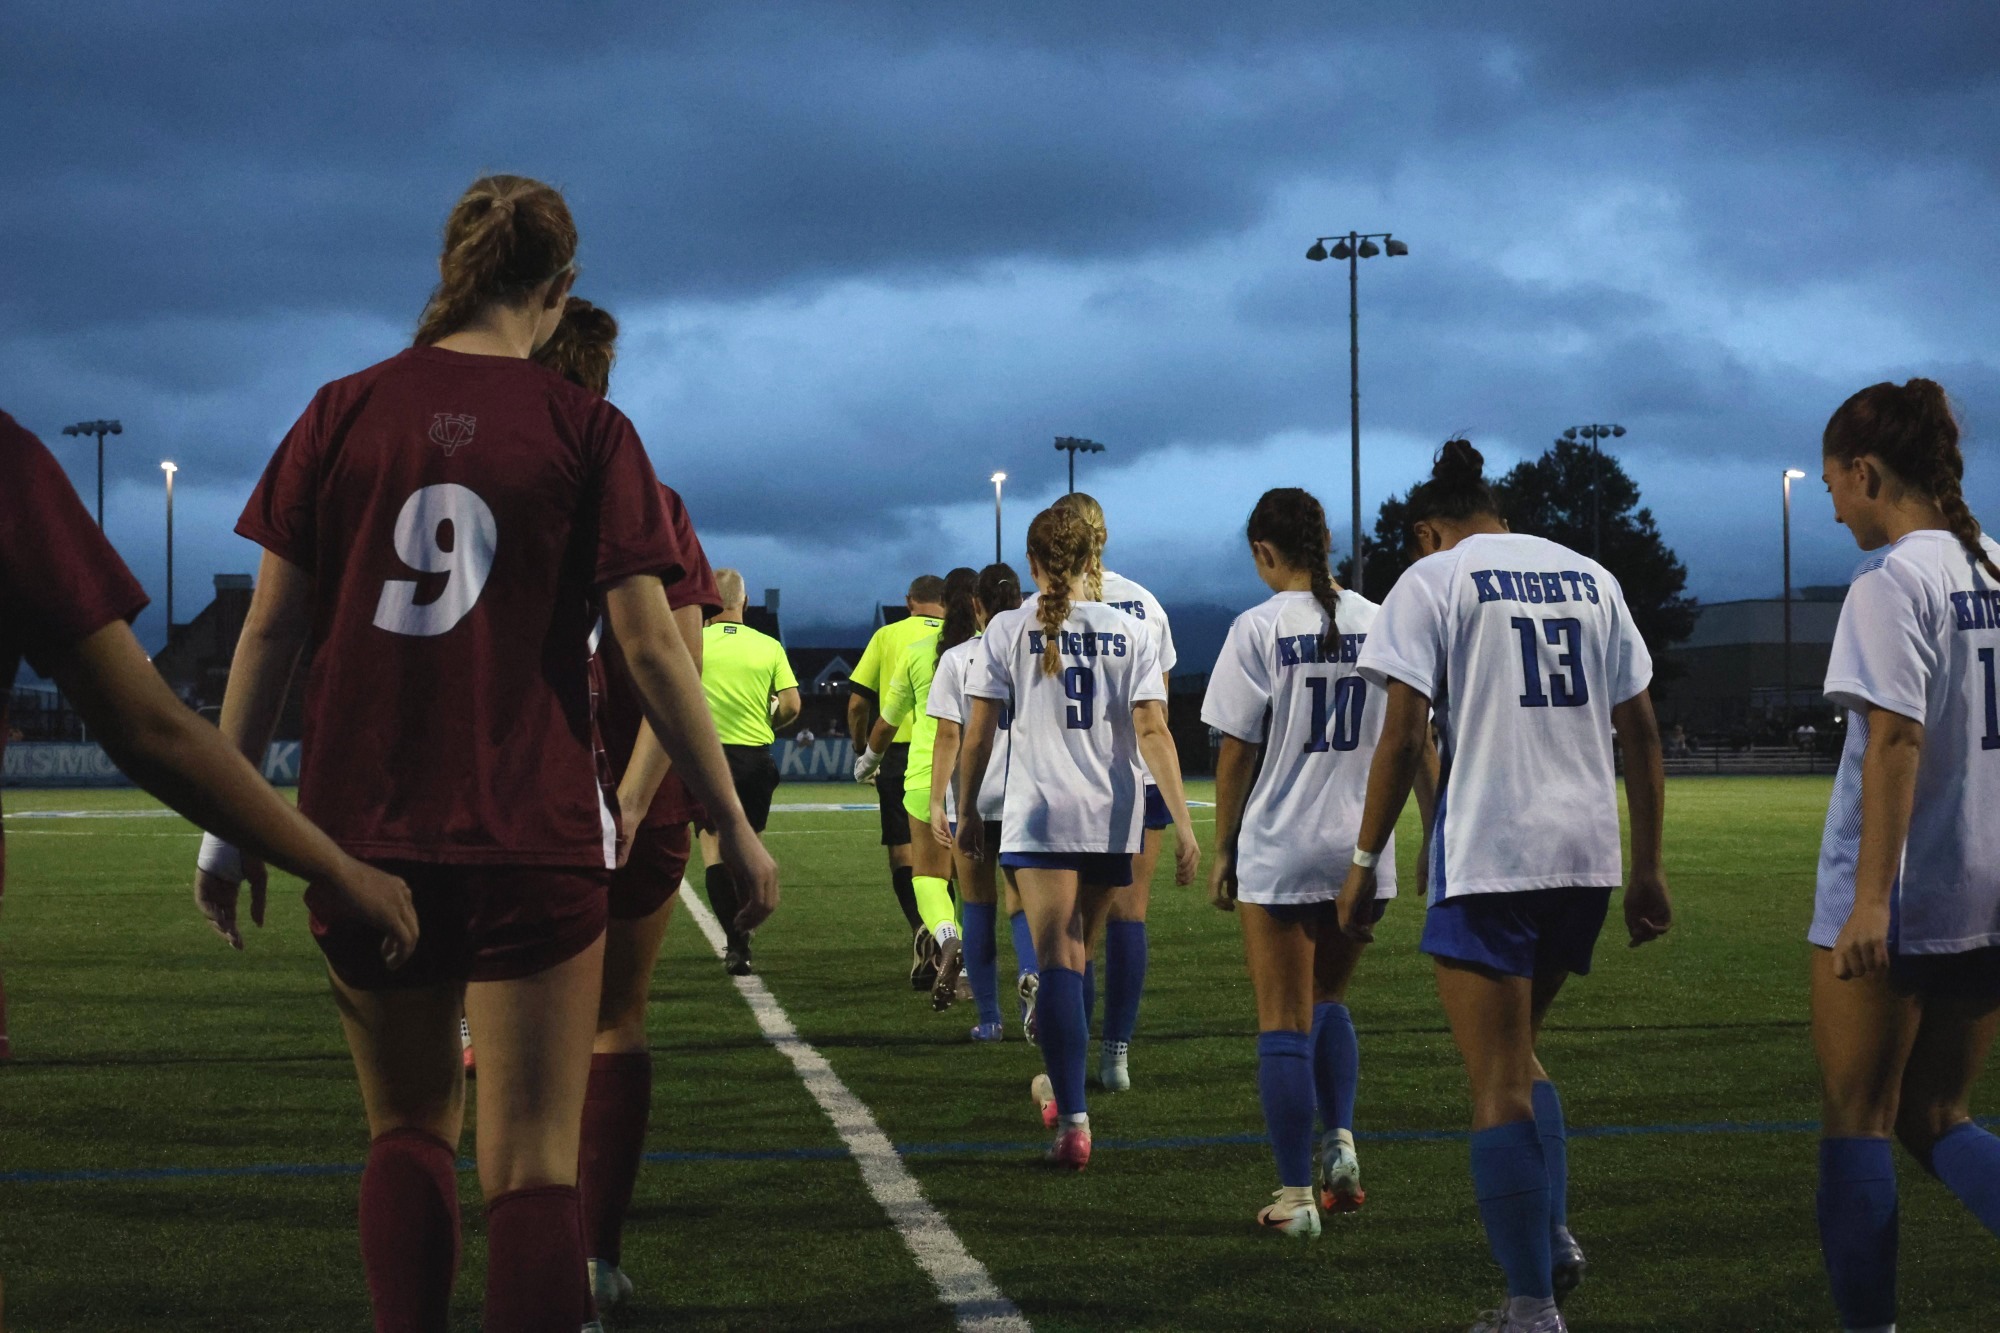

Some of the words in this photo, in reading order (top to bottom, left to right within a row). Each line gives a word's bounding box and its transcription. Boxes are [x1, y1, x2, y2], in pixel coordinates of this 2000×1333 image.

[372, 483, 498, 637] 9
[1470, 569, 1600, 605] KNIGHTS
[1107, 600, 1146, 620] TS
[1028, 630, 1127, 658] KIGHTS
[1511, 616, 1589, 708] 13
[1064, 666, 1094, 730] 9
[1303, 676, 1367, 754] 10
